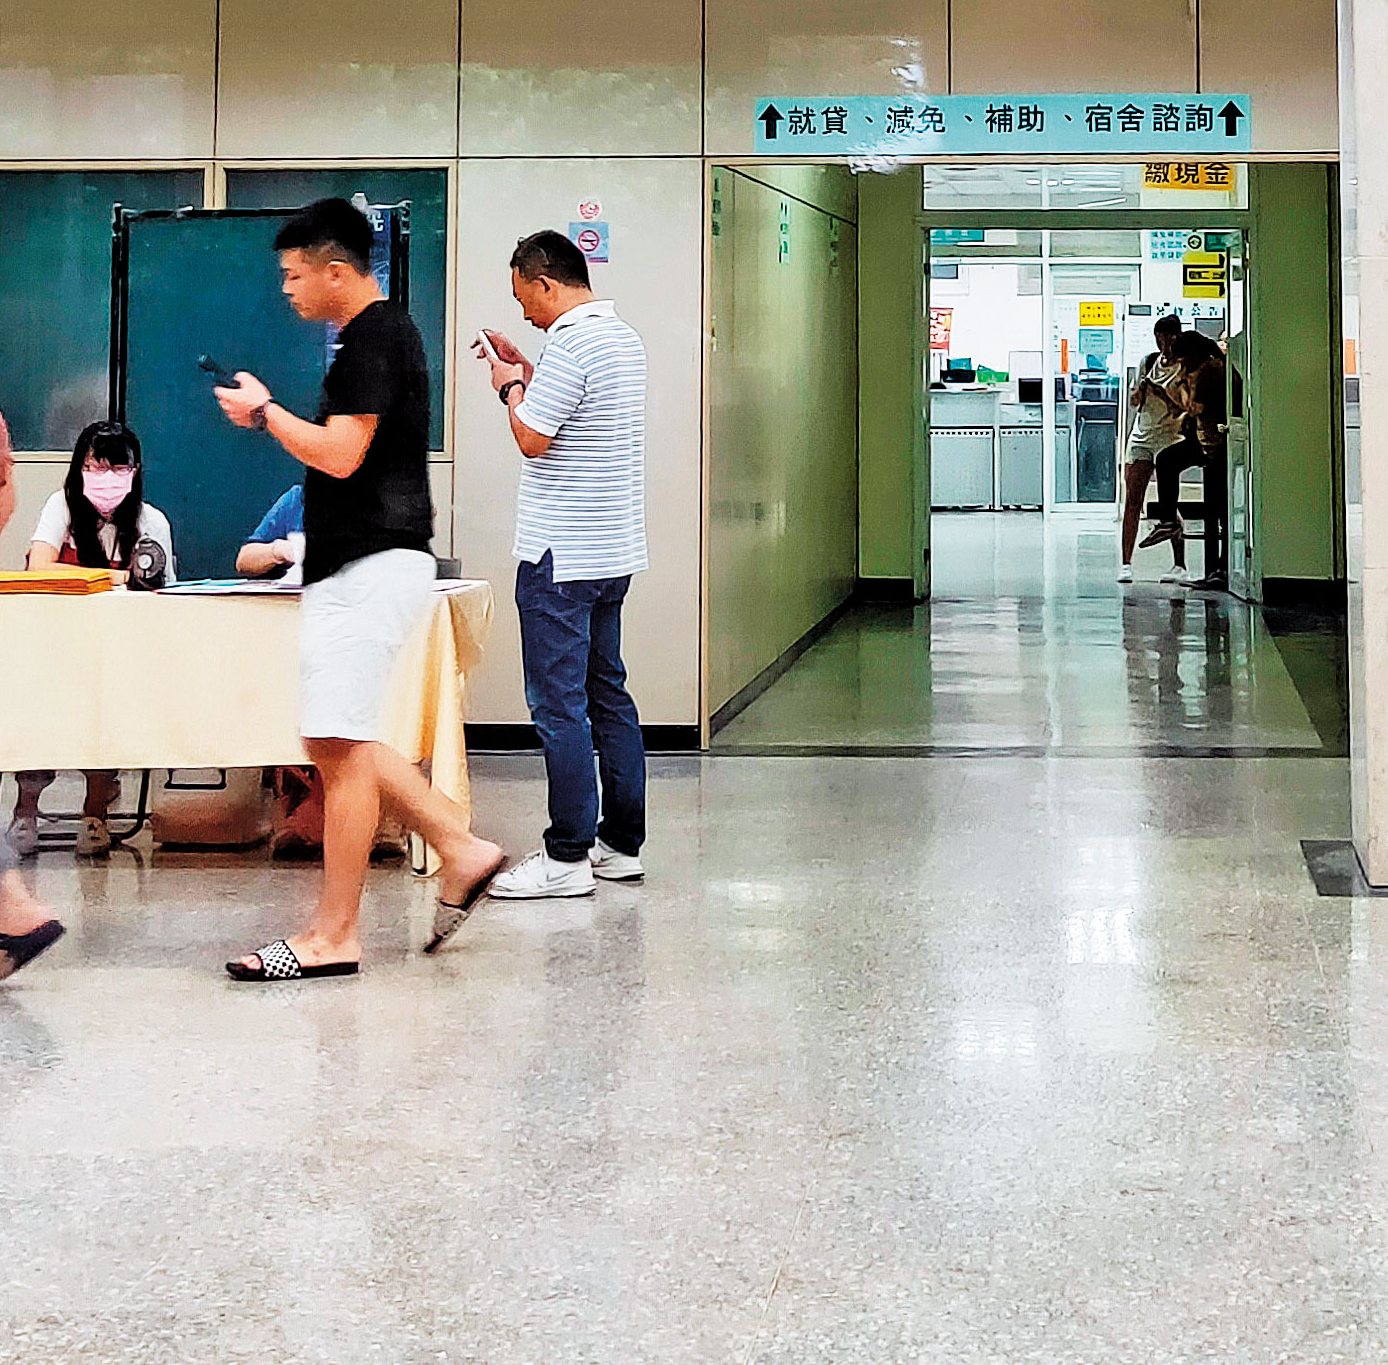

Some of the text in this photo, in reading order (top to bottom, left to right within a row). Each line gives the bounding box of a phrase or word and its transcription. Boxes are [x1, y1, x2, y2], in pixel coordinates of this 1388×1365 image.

[787, 102, 1215, 135] 就貸、減免、補助、宿舍諮詢
